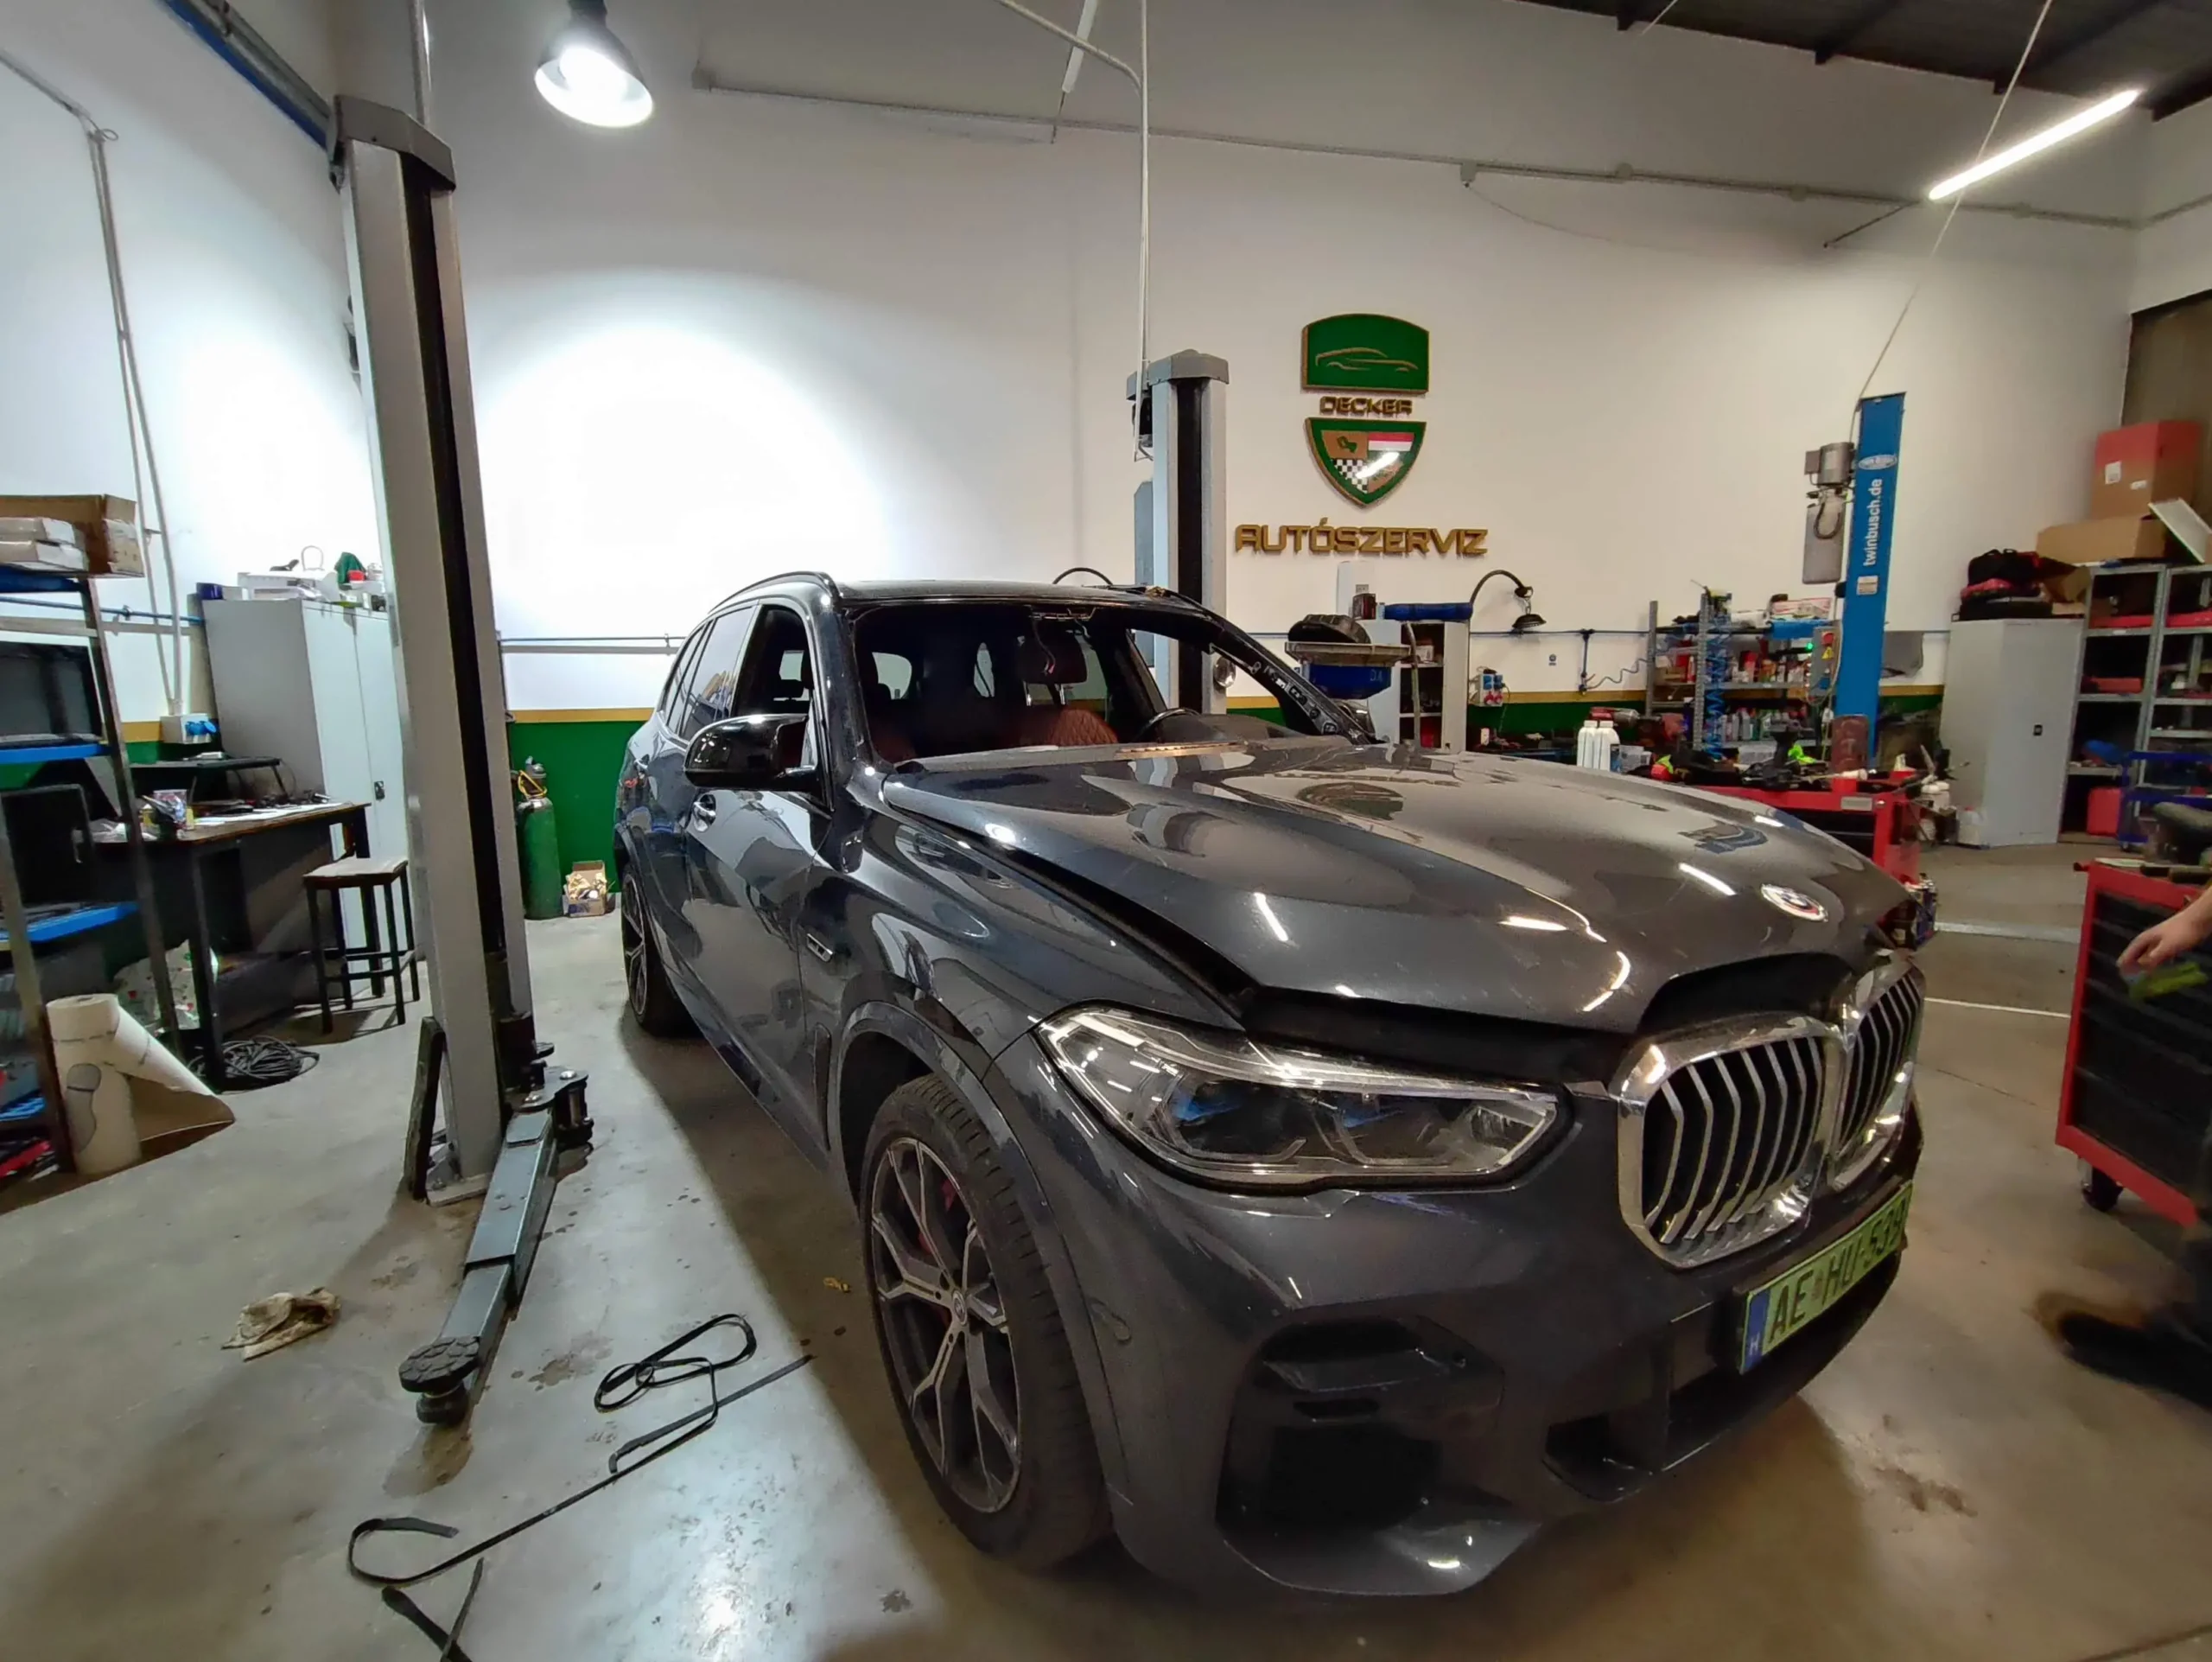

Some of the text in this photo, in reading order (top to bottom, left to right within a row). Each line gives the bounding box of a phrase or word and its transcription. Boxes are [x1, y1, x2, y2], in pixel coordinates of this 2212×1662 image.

[1319, 396, 1413, 416] DECKER
[1236, 517, 1488, 555] AUTÓSZERVIZ
[1863, 479, 1883, 566] twinbusch.de
[1770, 1268, 1814, 1343] AE
